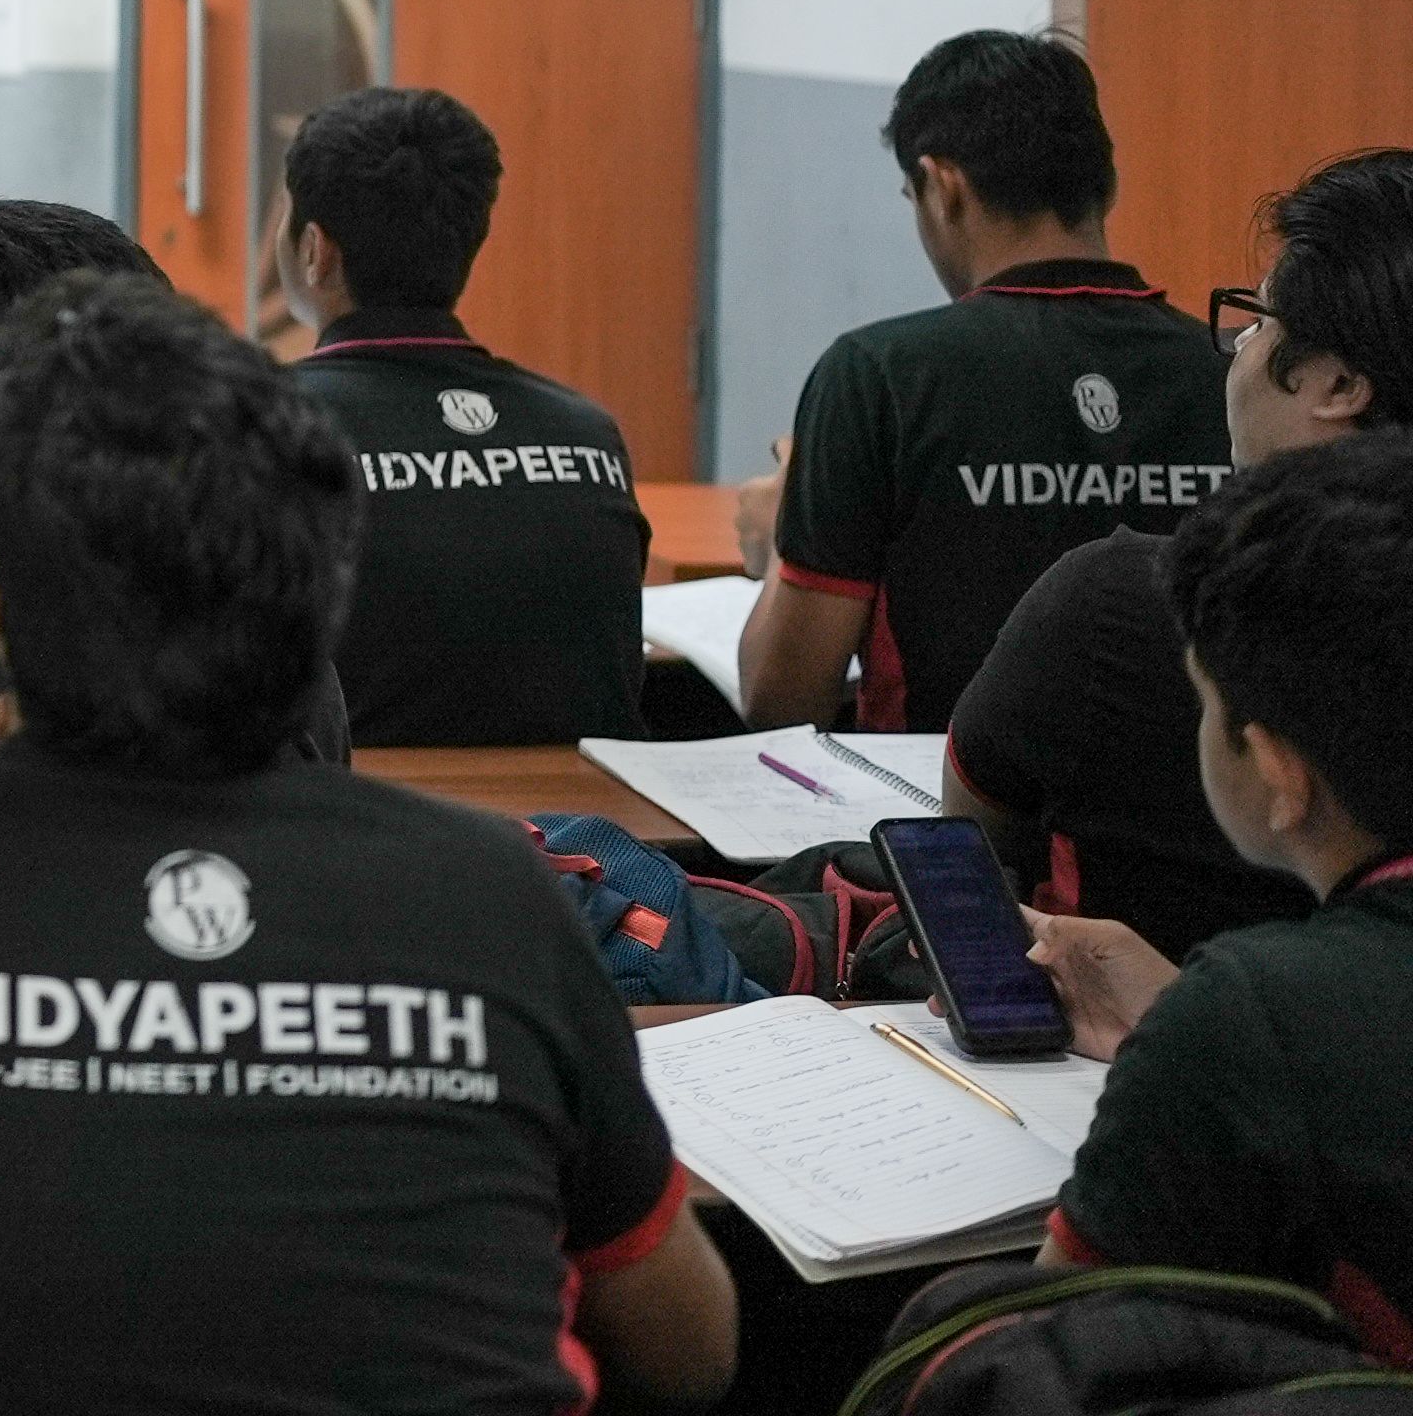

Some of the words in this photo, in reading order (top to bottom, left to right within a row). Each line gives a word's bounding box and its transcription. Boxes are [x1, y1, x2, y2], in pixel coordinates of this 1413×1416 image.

[353, 445, 628, 493] IDYAPEETH
[957, 463, 1234, 506] VIDYAPEET
[109, 1063, 219, 1095] NEET
[246, 1064, 499, 1103] FOUNDATION
